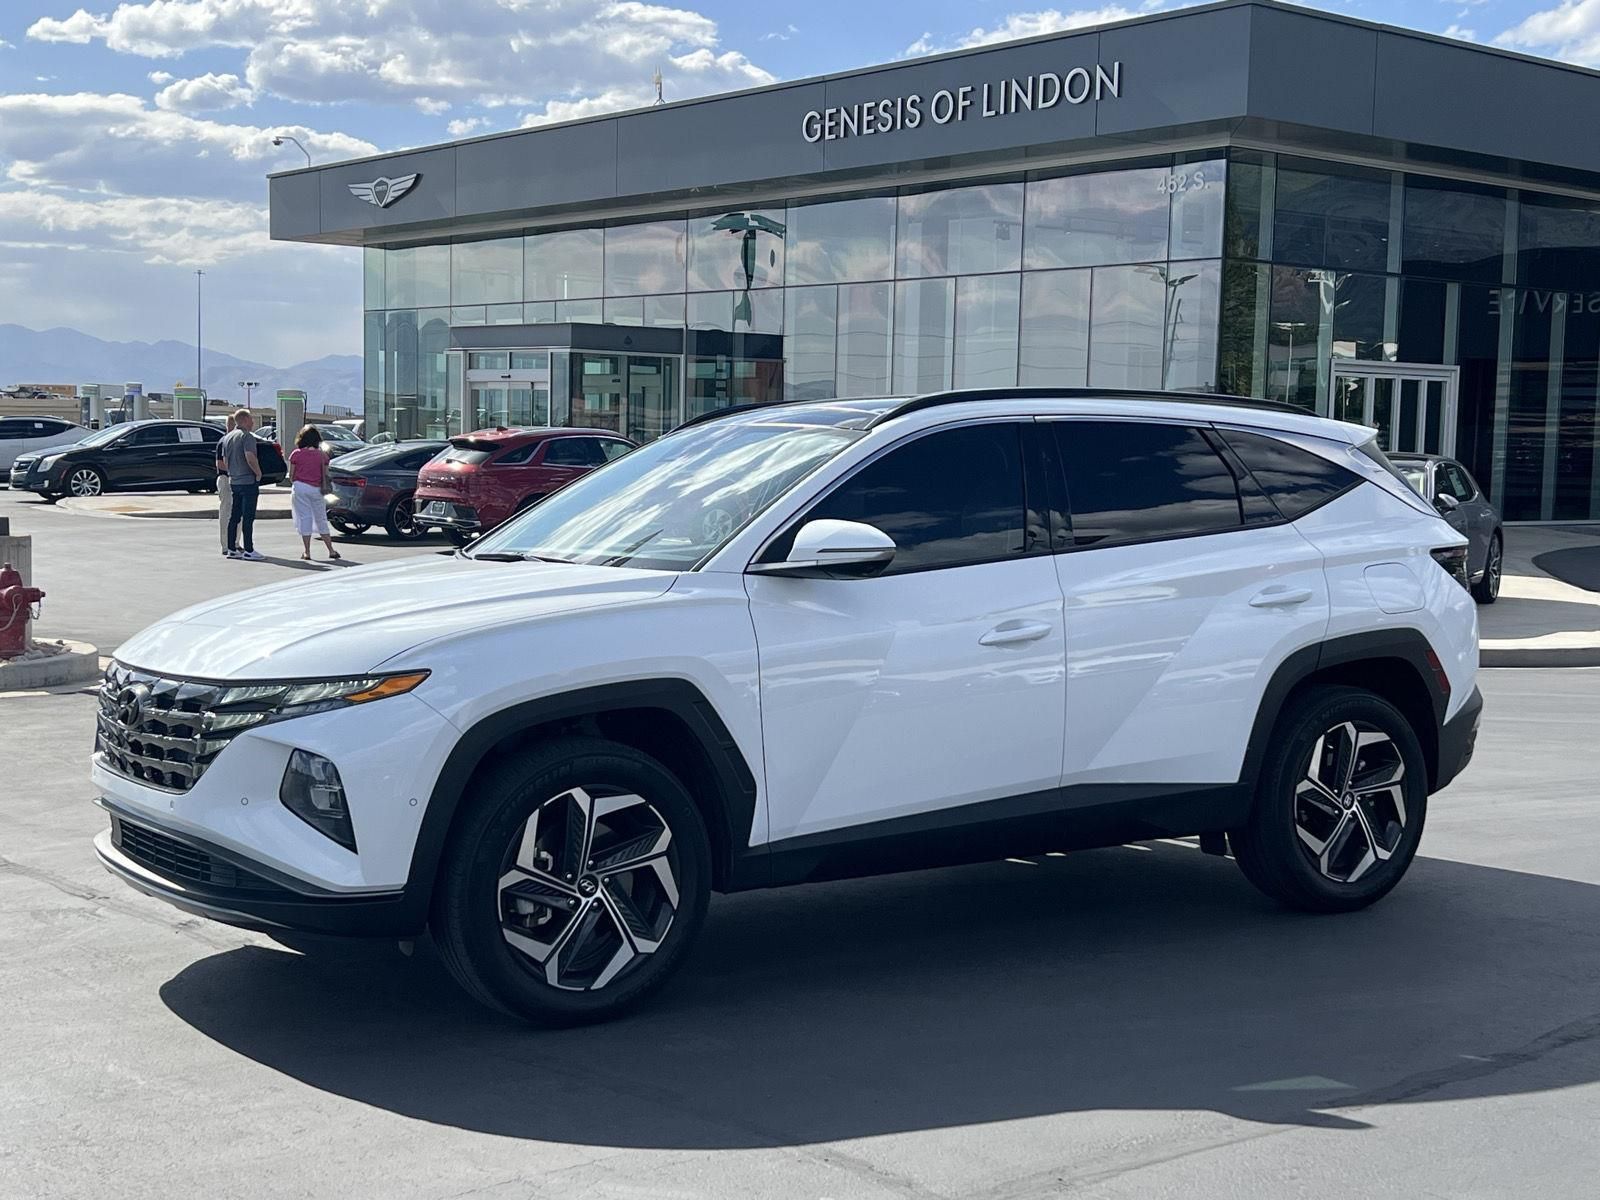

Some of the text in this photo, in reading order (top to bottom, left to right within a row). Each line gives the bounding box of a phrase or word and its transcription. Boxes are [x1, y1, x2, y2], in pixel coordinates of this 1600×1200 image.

[802, 61, 1119, 143] GENESIS OF LINDON
[1193, 171, 1210, 190] S.
